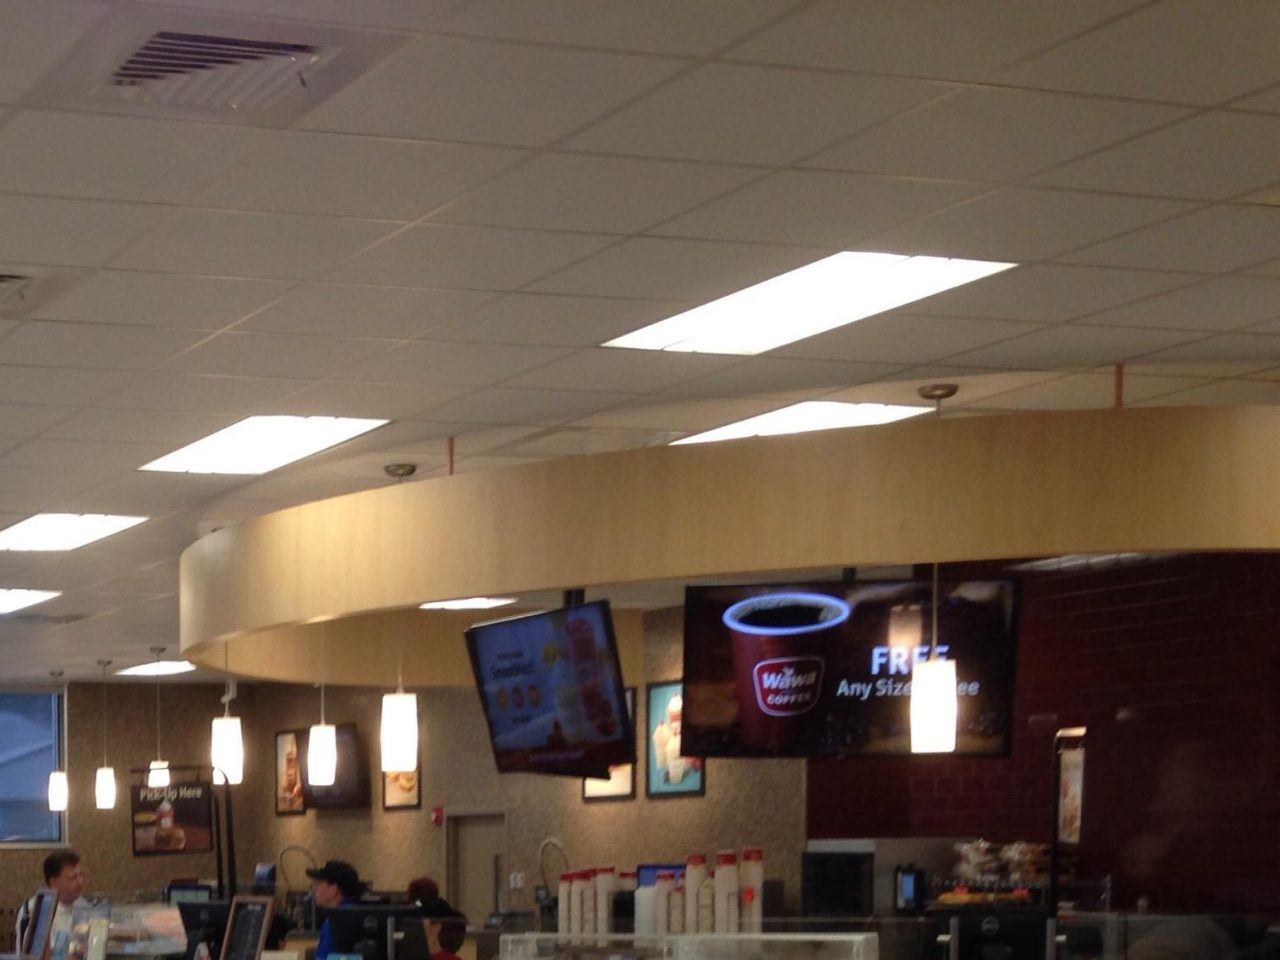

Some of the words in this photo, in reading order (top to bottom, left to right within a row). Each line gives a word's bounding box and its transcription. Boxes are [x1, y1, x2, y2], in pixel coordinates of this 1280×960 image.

[836, 679, 872, 701] Any
[875, 678, 912, 696] Size
[179, 785, 202, 799] Here
